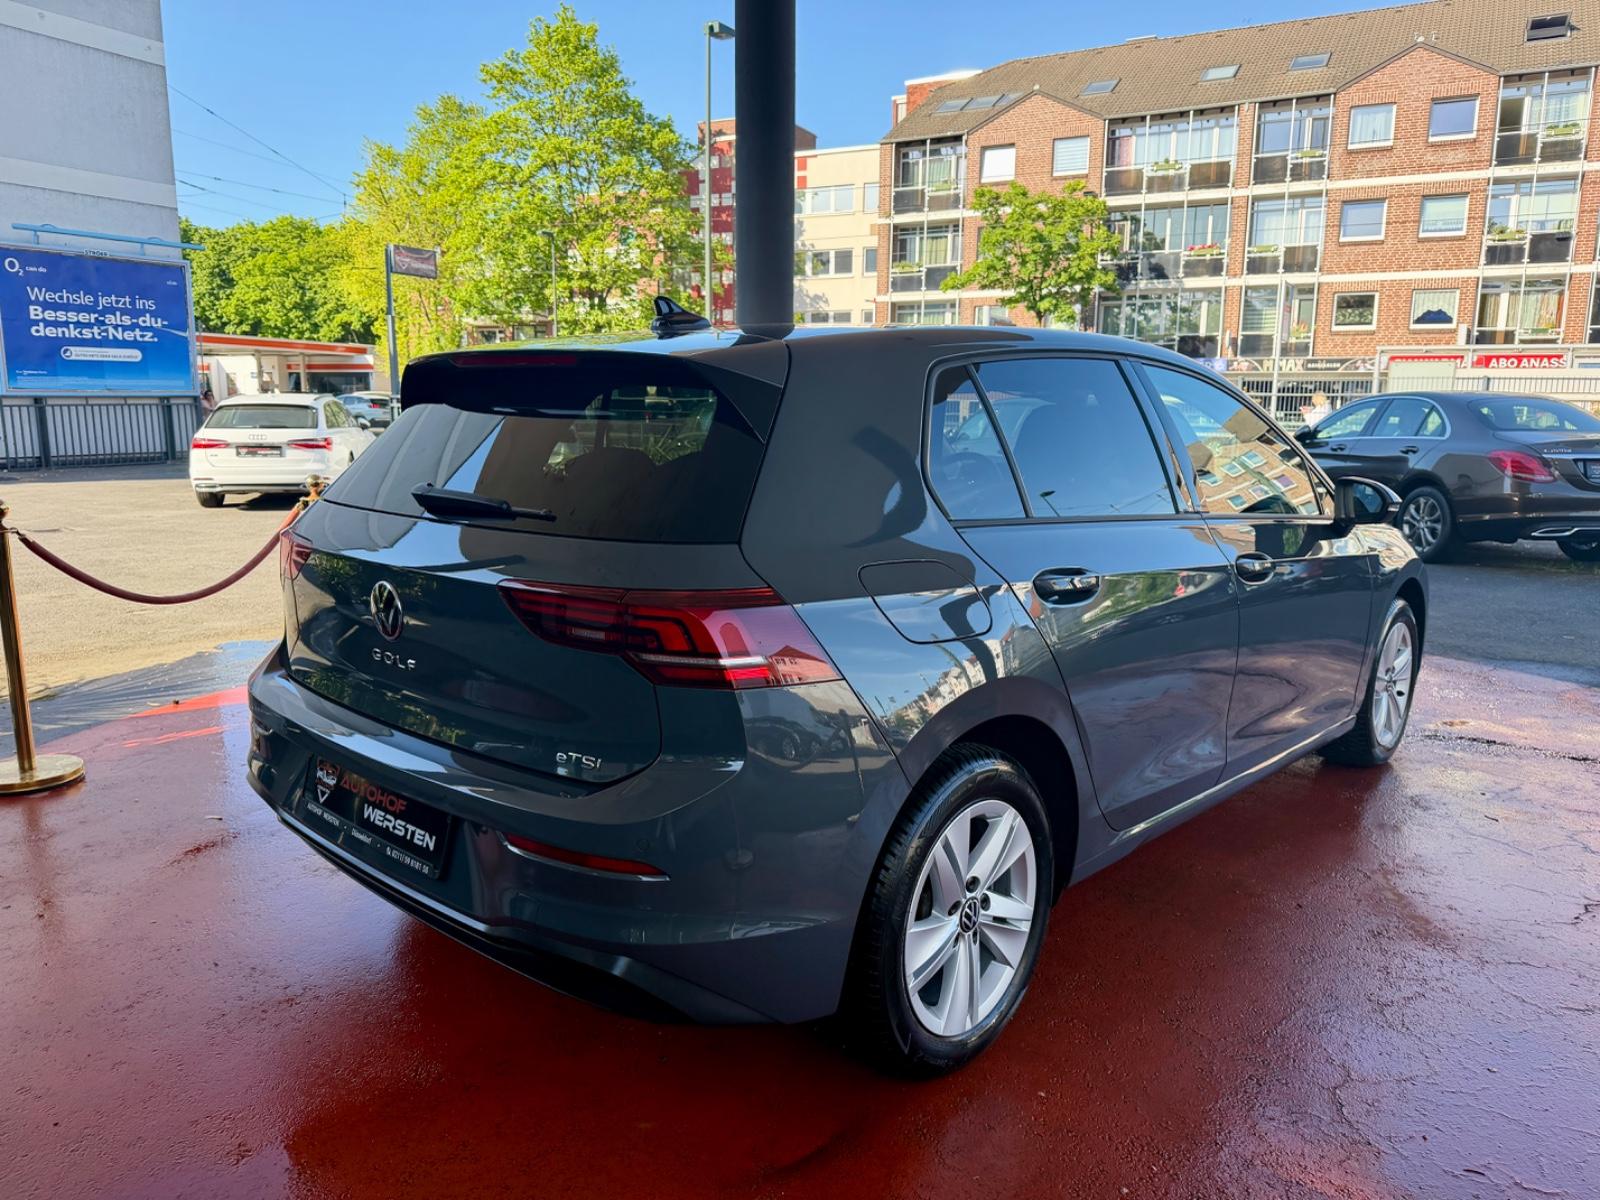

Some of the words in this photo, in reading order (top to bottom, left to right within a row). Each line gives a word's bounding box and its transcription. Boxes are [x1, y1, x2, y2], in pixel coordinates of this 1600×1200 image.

[27, 286, 94, 305] Wechsle
[97, 292, 132, 310] jetzt
[135, 295, 156, 310] ins
[29, 305, 168, 327] Besser-als-du-
[31, 323, 158, 342] denkst-Netz.
[1489, 357, 1519, 369] ABO
[1519, 357, 1567, 369] ANASS
[372, 648, 416, 671] GOLF
[556, 752, 602, 769] eTSI
[340, 774, 408, 813] AUTOHOF
[363, 803, 436, 851] WERSTEN
